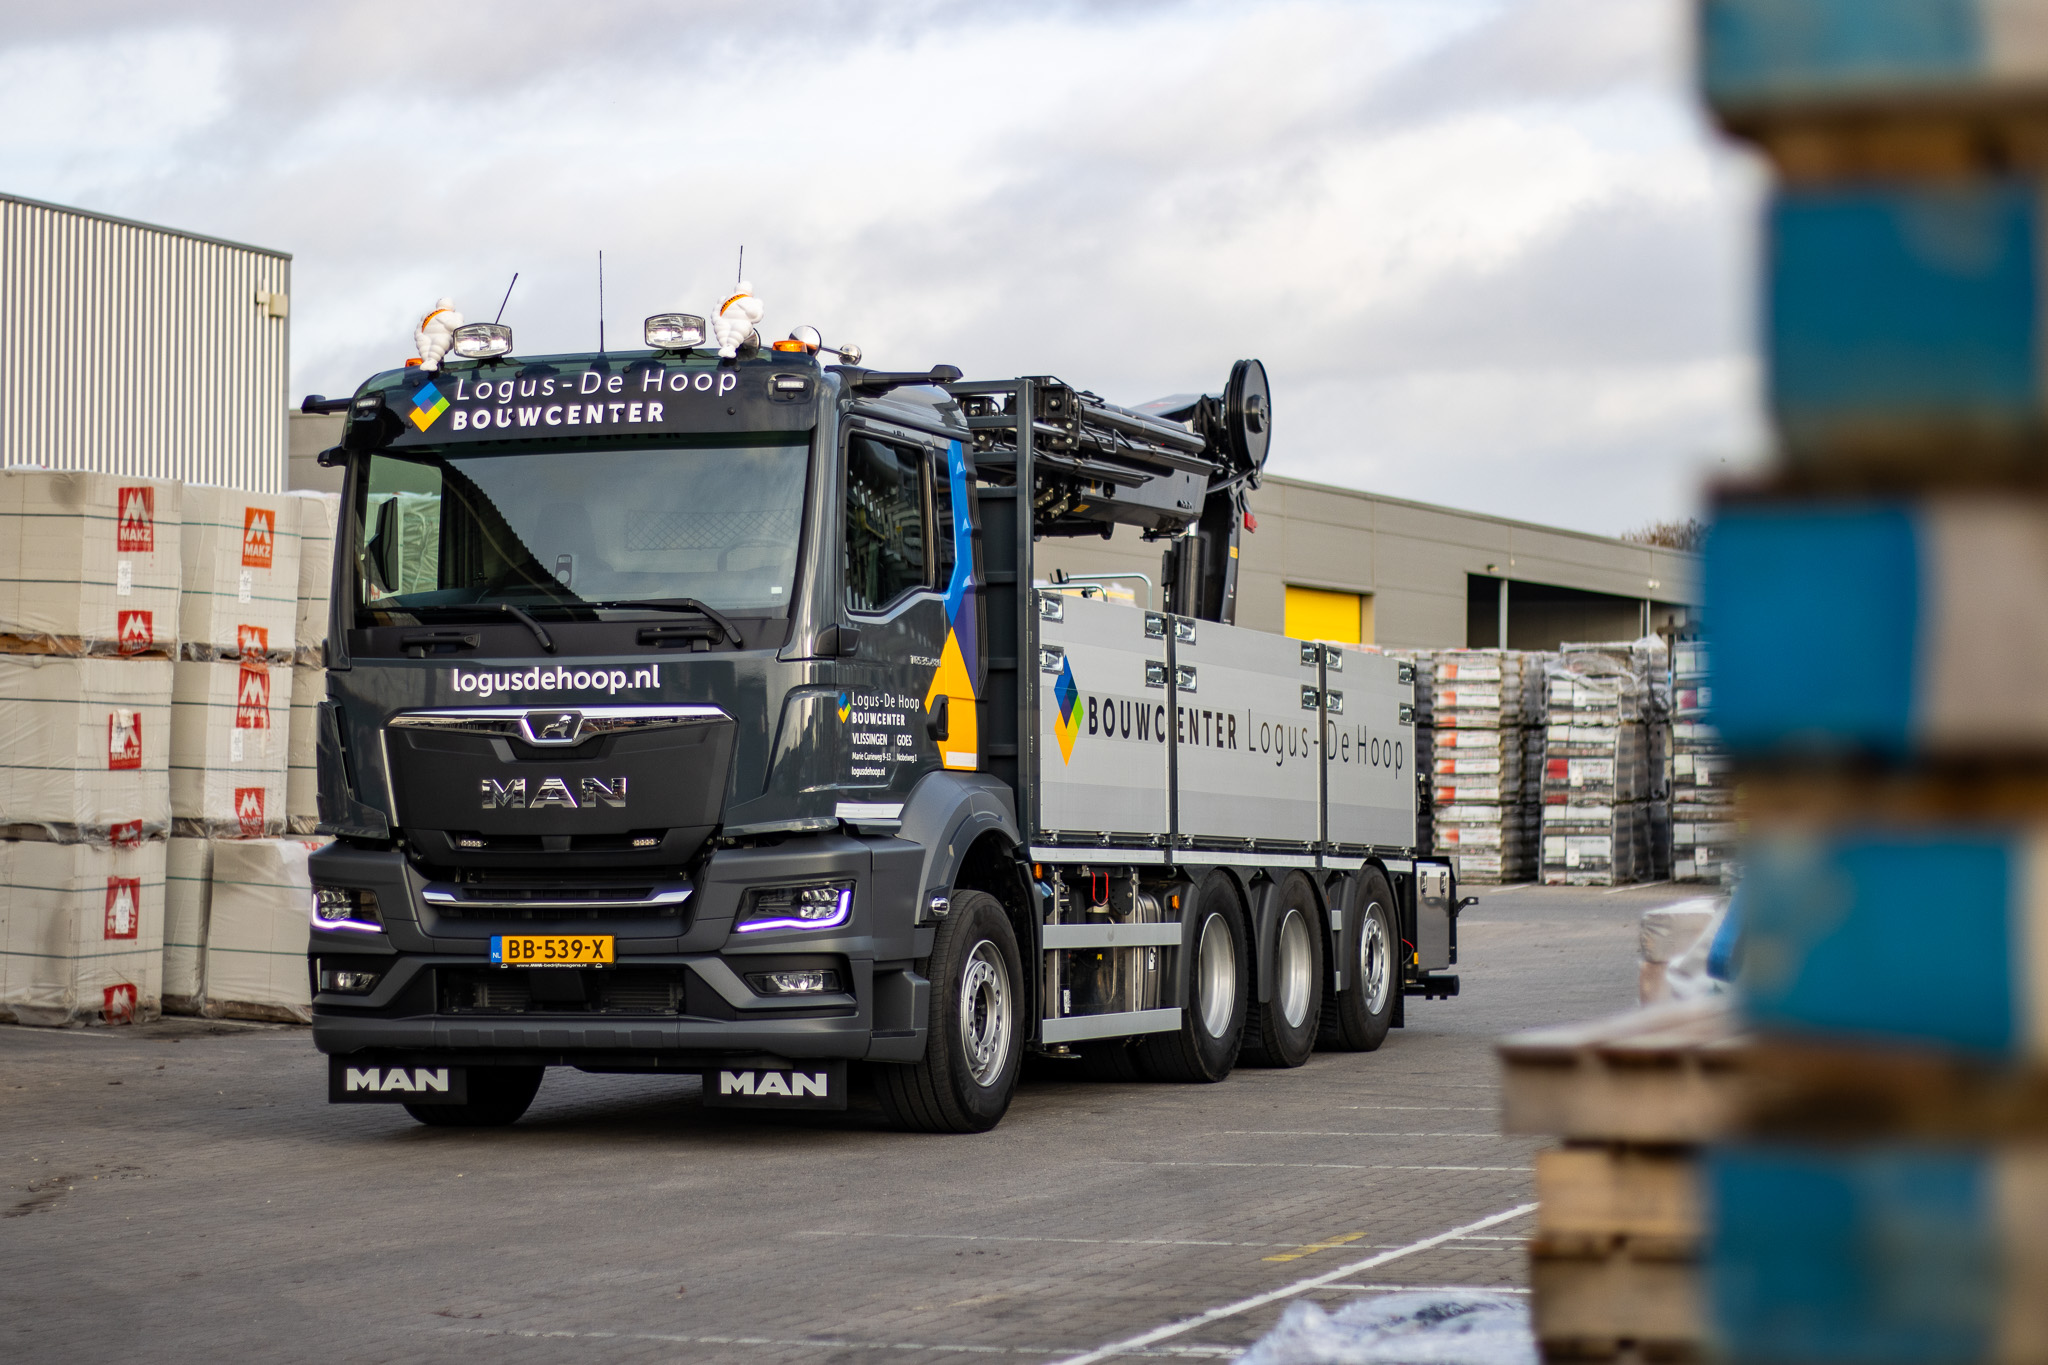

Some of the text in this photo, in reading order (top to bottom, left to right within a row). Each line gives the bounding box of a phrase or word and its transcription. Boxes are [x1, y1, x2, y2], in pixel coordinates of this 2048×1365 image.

[456, 369, 737, 404] Logus-De Hoop
[452, 402, 664, 431] BOUWCENTER
[120, 528, 150, 541] MAKZ
[244, 543, 271, 557] MAKZ
[453, 664, 660, 697] logusdehoop.nl
[852, 691, 920, 712] Logus-De Hoop
[852, 711, 906, 726] BOUWCENTER
[852, 732, 888, 746] VLISSINGEN
[896, 734, 913, 747] GOES
[1088, 696, 1237, 750] BOUWCENTER
[1357, 724, 1403, 780] Hoop
[482, 777, 627, 809] MAN
[508, 939, 604, 960] BB-539-X
[346, 1068, 449, 1092] MAN
[720, 1071, 828, 1097] MAN
